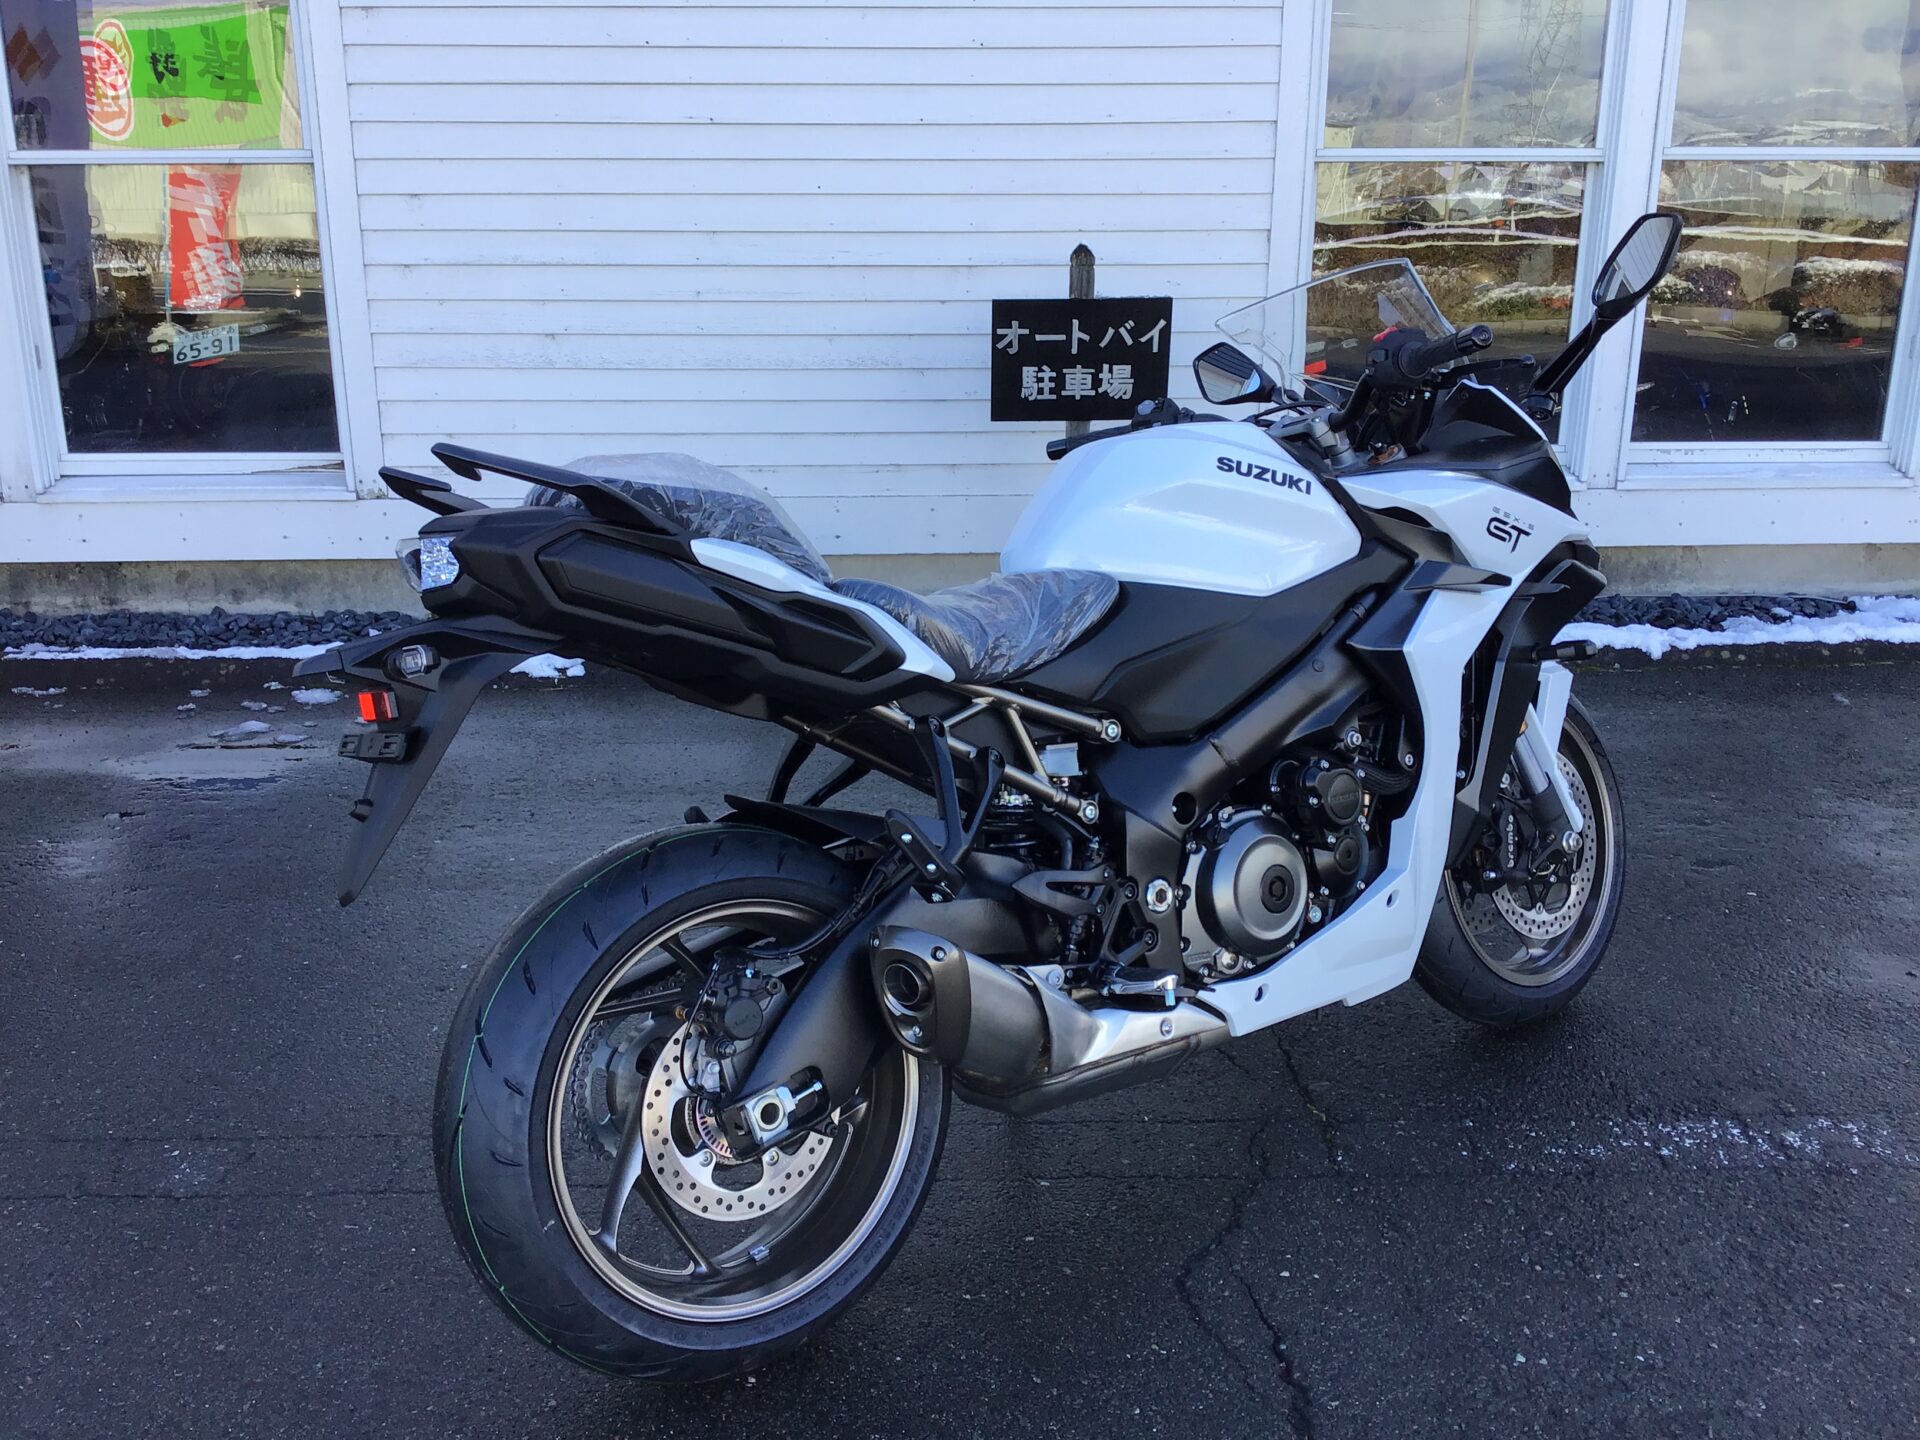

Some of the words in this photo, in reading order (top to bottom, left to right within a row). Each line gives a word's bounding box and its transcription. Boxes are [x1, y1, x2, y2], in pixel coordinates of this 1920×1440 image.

[176, 335, 233, 361] 65-91
[996, 318, 1167, 354] オートバイ
[1020, 364, 1134, 401] 駐車場
[1216, 456, 1311, 495] SUZUKI
[1506, 814, 1515, 868] brembo
